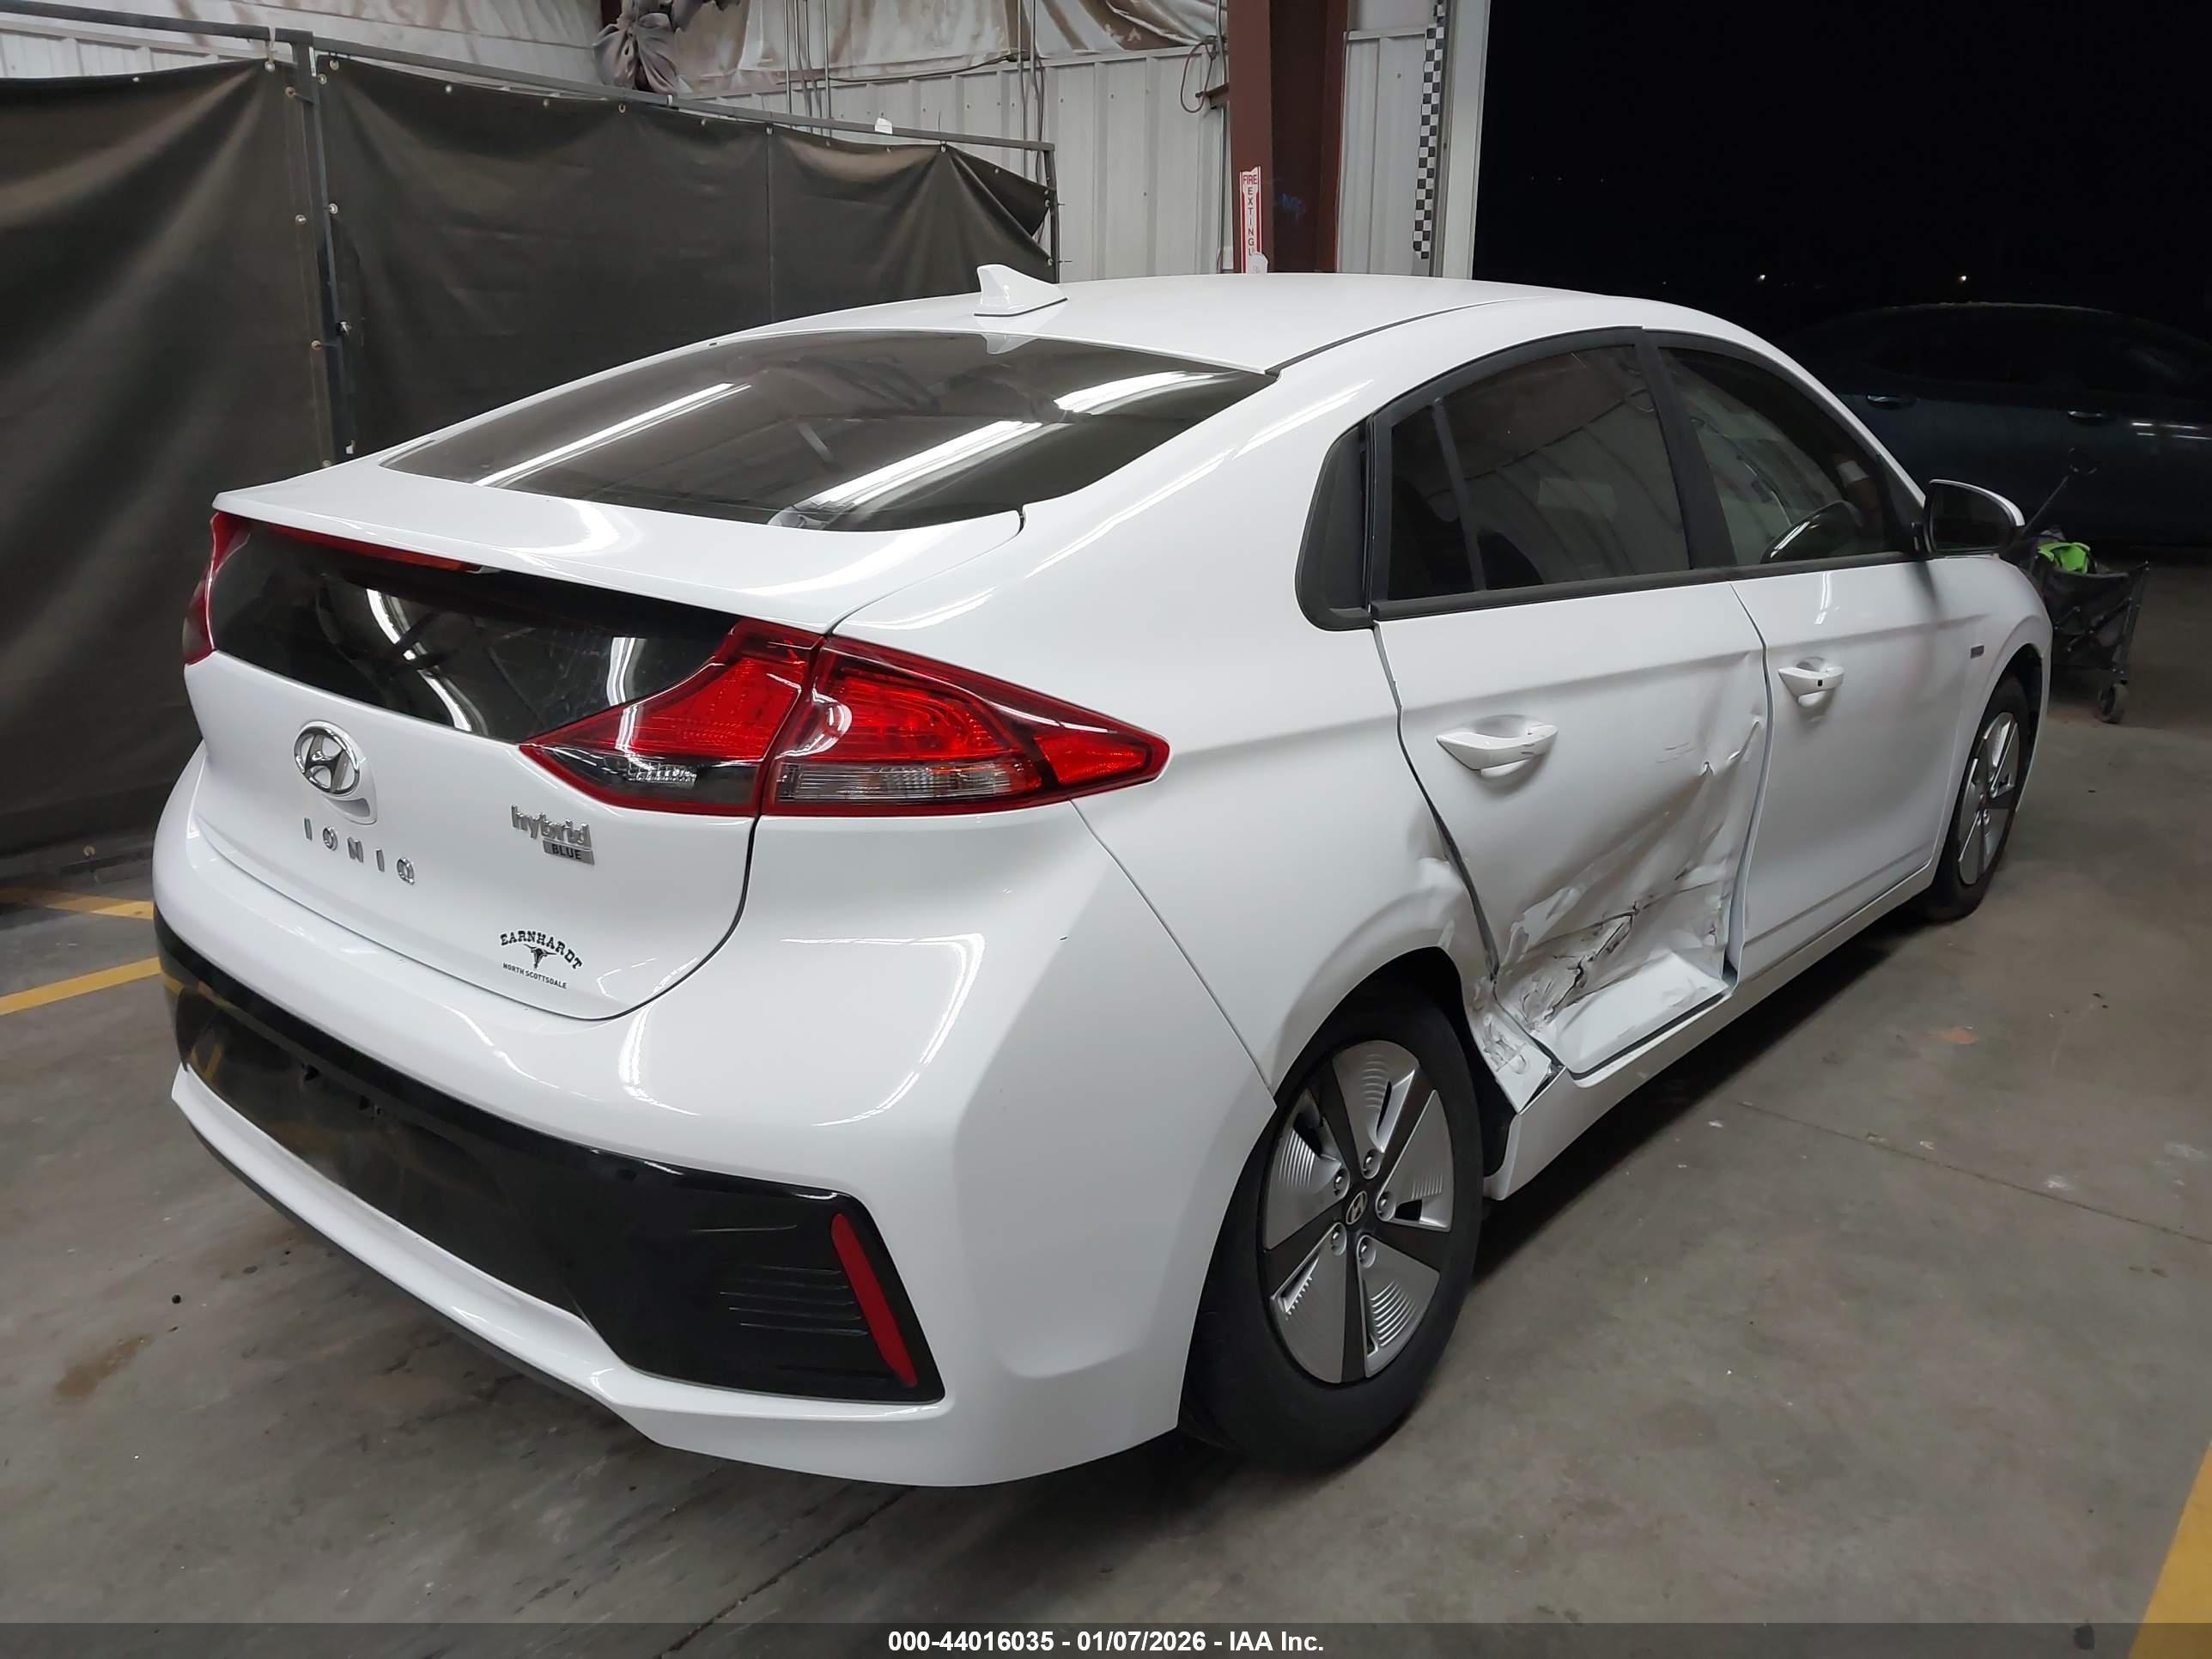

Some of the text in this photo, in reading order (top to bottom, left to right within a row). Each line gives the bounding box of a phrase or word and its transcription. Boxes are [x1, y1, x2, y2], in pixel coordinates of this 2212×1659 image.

[1243, 174, 1258, 185] FIRE
[511, 804, 592, 848] hybrid
[303, 817, 415, 885] IONIQ
[551, 843, 582, 860] BLUE
[500, 930, 582, 969] EARNHARDT
[502, 962, 568, 989] NORTH SCOTTSDALE
